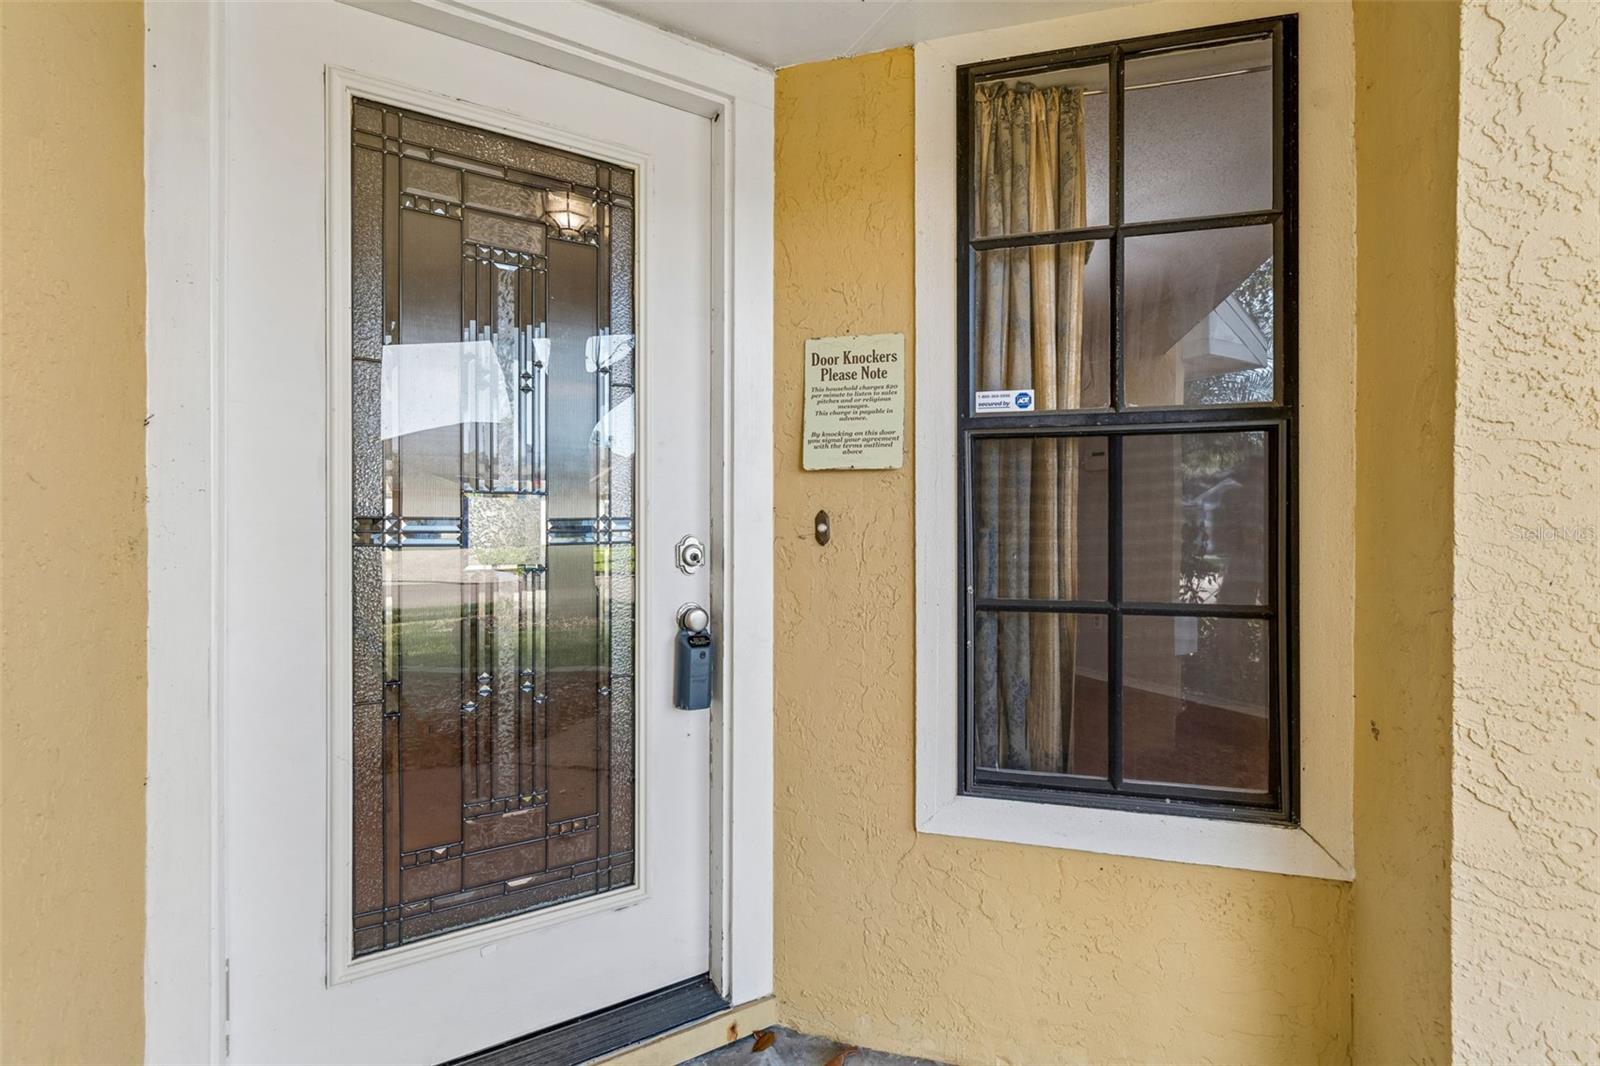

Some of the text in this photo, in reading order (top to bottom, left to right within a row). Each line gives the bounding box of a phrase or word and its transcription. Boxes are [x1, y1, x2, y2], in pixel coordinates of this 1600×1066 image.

[811, 349, 898, 366] Door Knockers
[821, 365, 888, 382] Please Note
